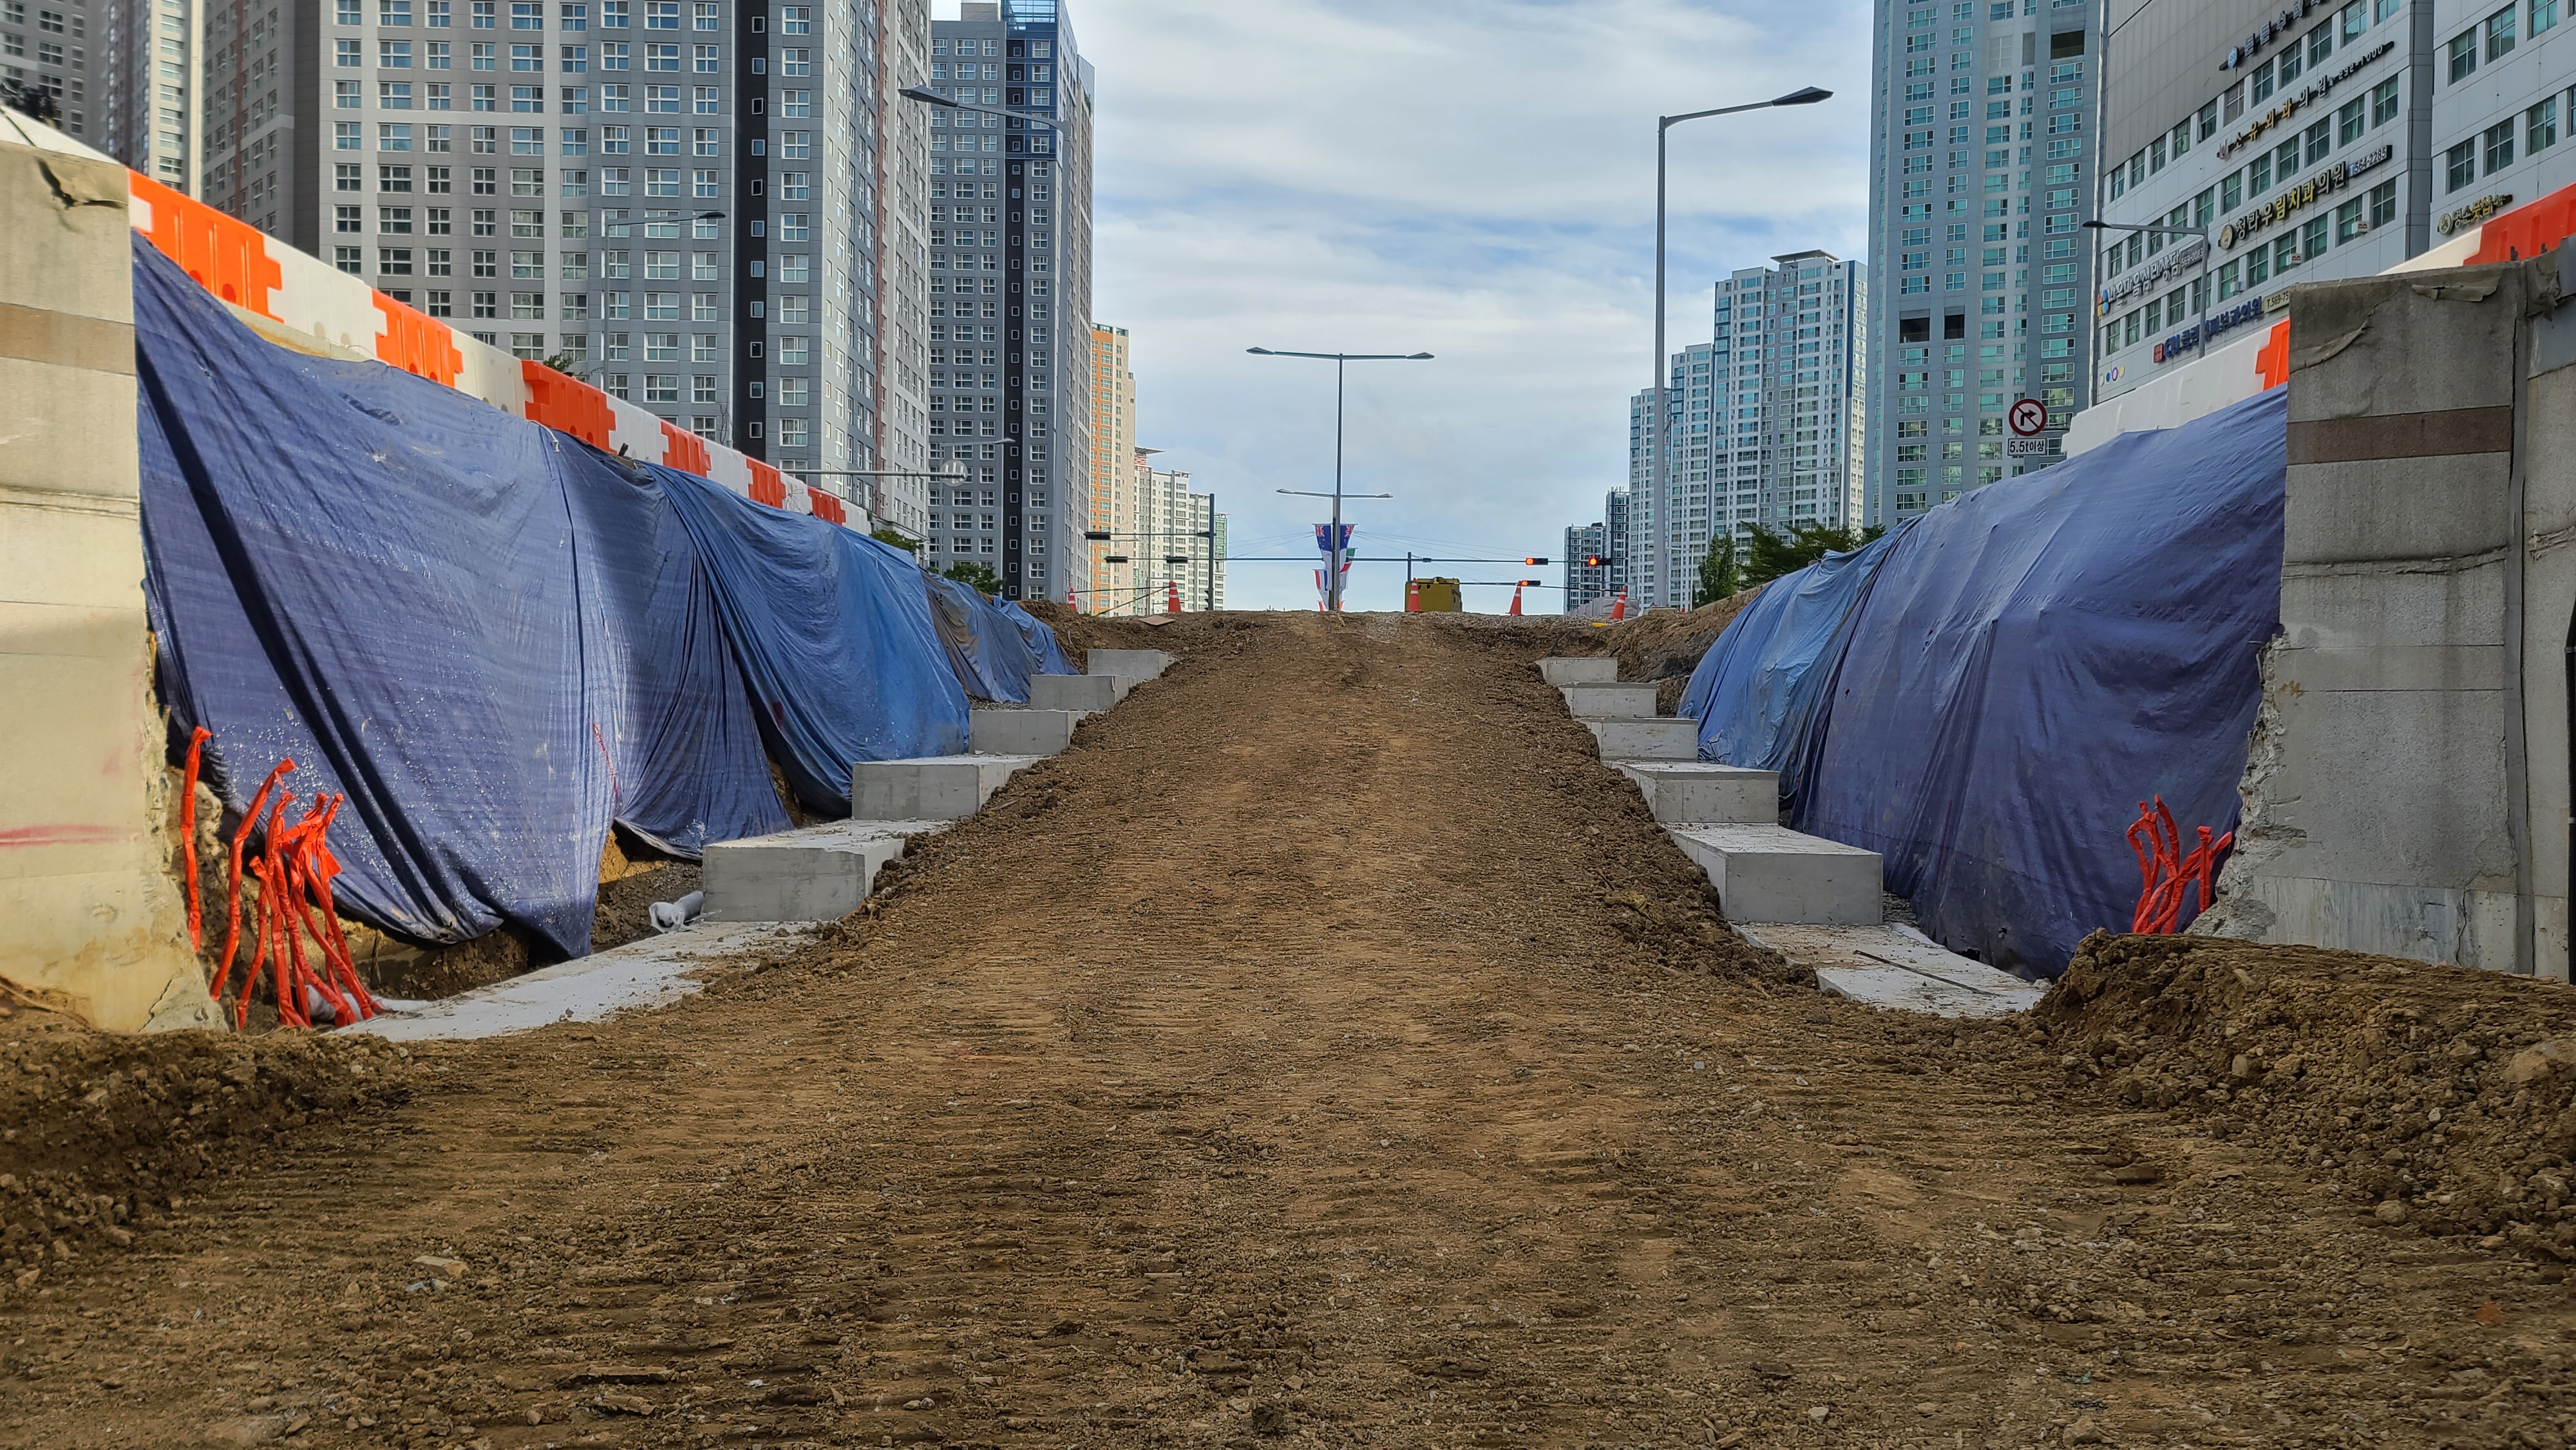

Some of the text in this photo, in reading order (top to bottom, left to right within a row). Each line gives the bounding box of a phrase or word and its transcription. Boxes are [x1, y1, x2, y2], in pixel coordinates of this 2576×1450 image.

[2236, 162, 2345, 240] 청라우림치과의원
[2108, 249, 2181, 306] 나은마음심리상담
[2010, 440, 2045, 453] 5.5t이상
